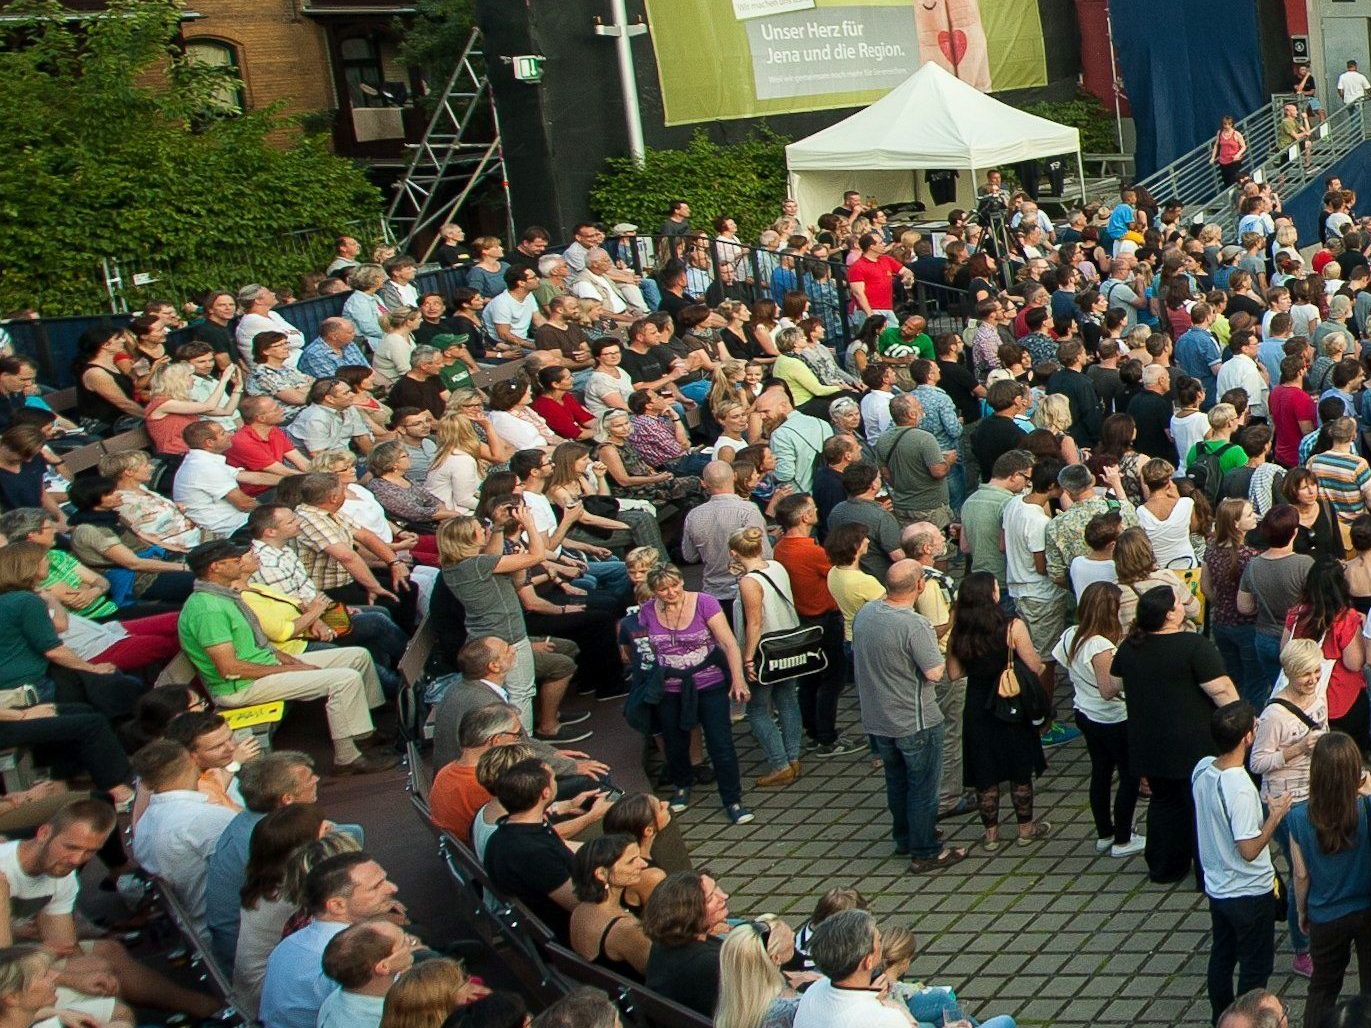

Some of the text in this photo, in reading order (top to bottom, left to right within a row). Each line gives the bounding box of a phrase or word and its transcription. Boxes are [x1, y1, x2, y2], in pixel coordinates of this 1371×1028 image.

[761, 20, 865, 41] Unser Herz für
[766, 41, 906, 64] Jena und die Region.
[769, 653, 807, 671] PUMA
